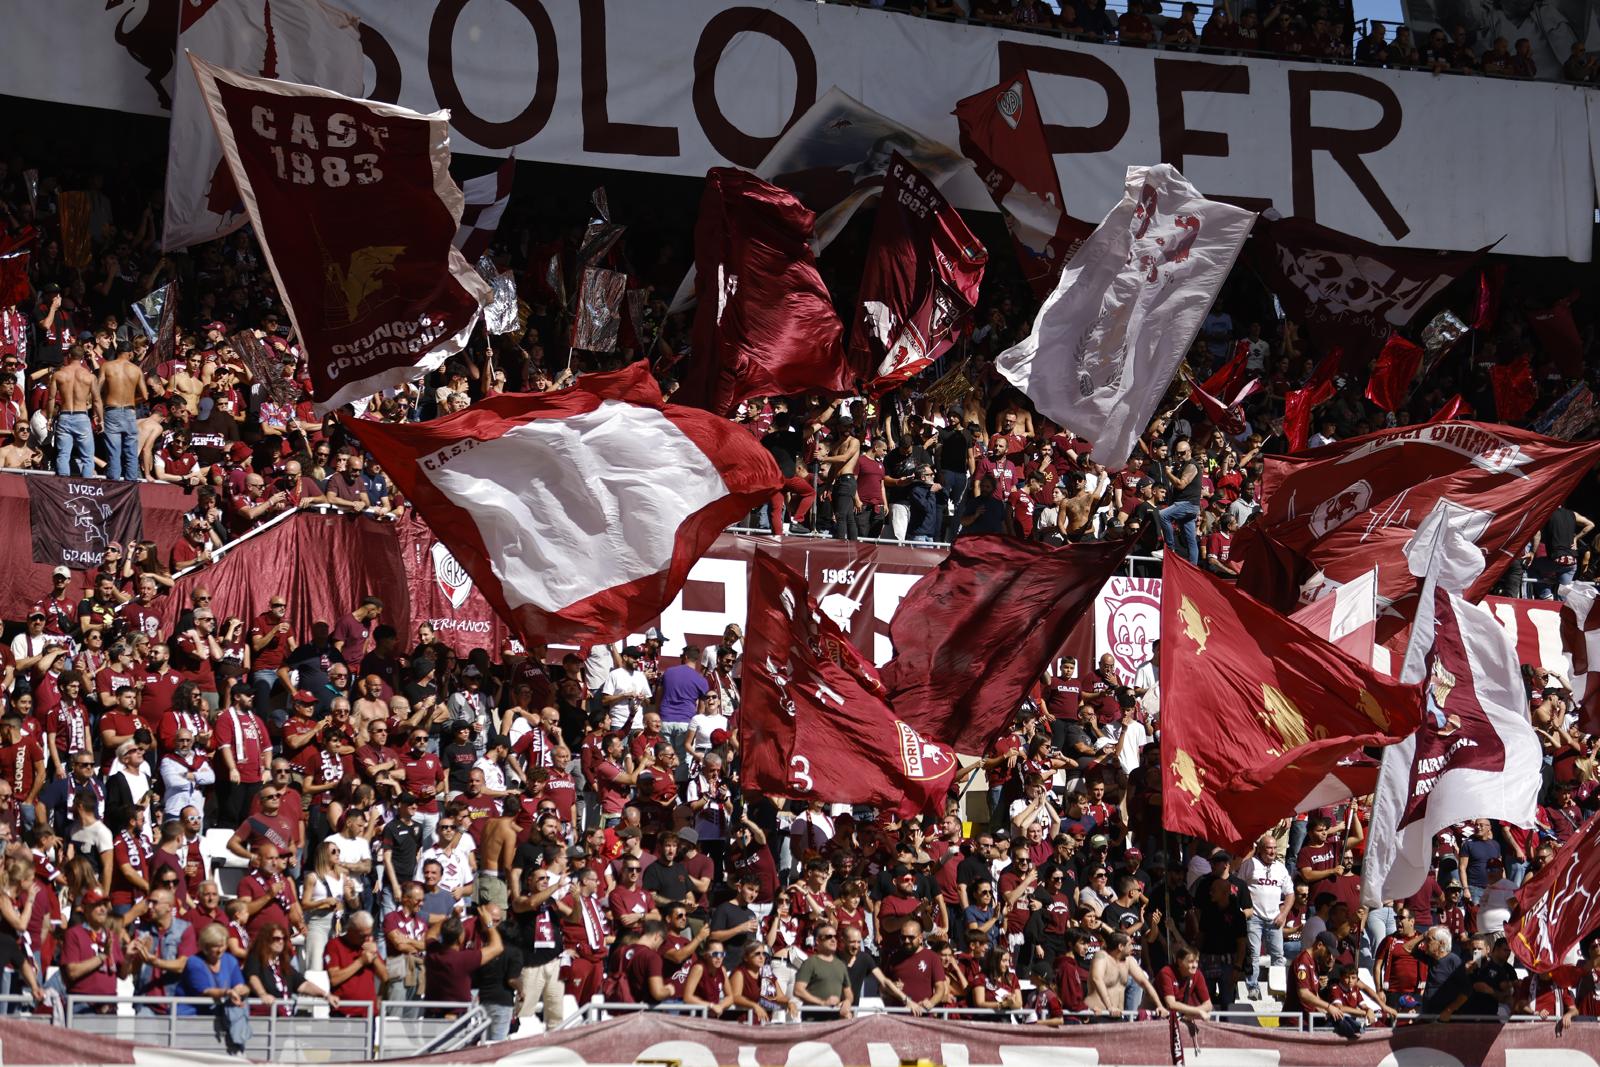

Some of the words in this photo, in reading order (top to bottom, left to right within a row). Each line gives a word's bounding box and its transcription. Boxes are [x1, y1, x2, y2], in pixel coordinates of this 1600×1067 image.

[251, 105, 390, 152] CAST
[998, 40, 1410, 241] PER
[270, 146, 384, 188] 1983
[68, 483, 104, 496] IVREA
[63, 549, 105, 564] GRANA
[822, 568, 855, 585] 1983
[1111, 577, 1161, 598] CAIR
[15, 745, 26, 777] TORINO
